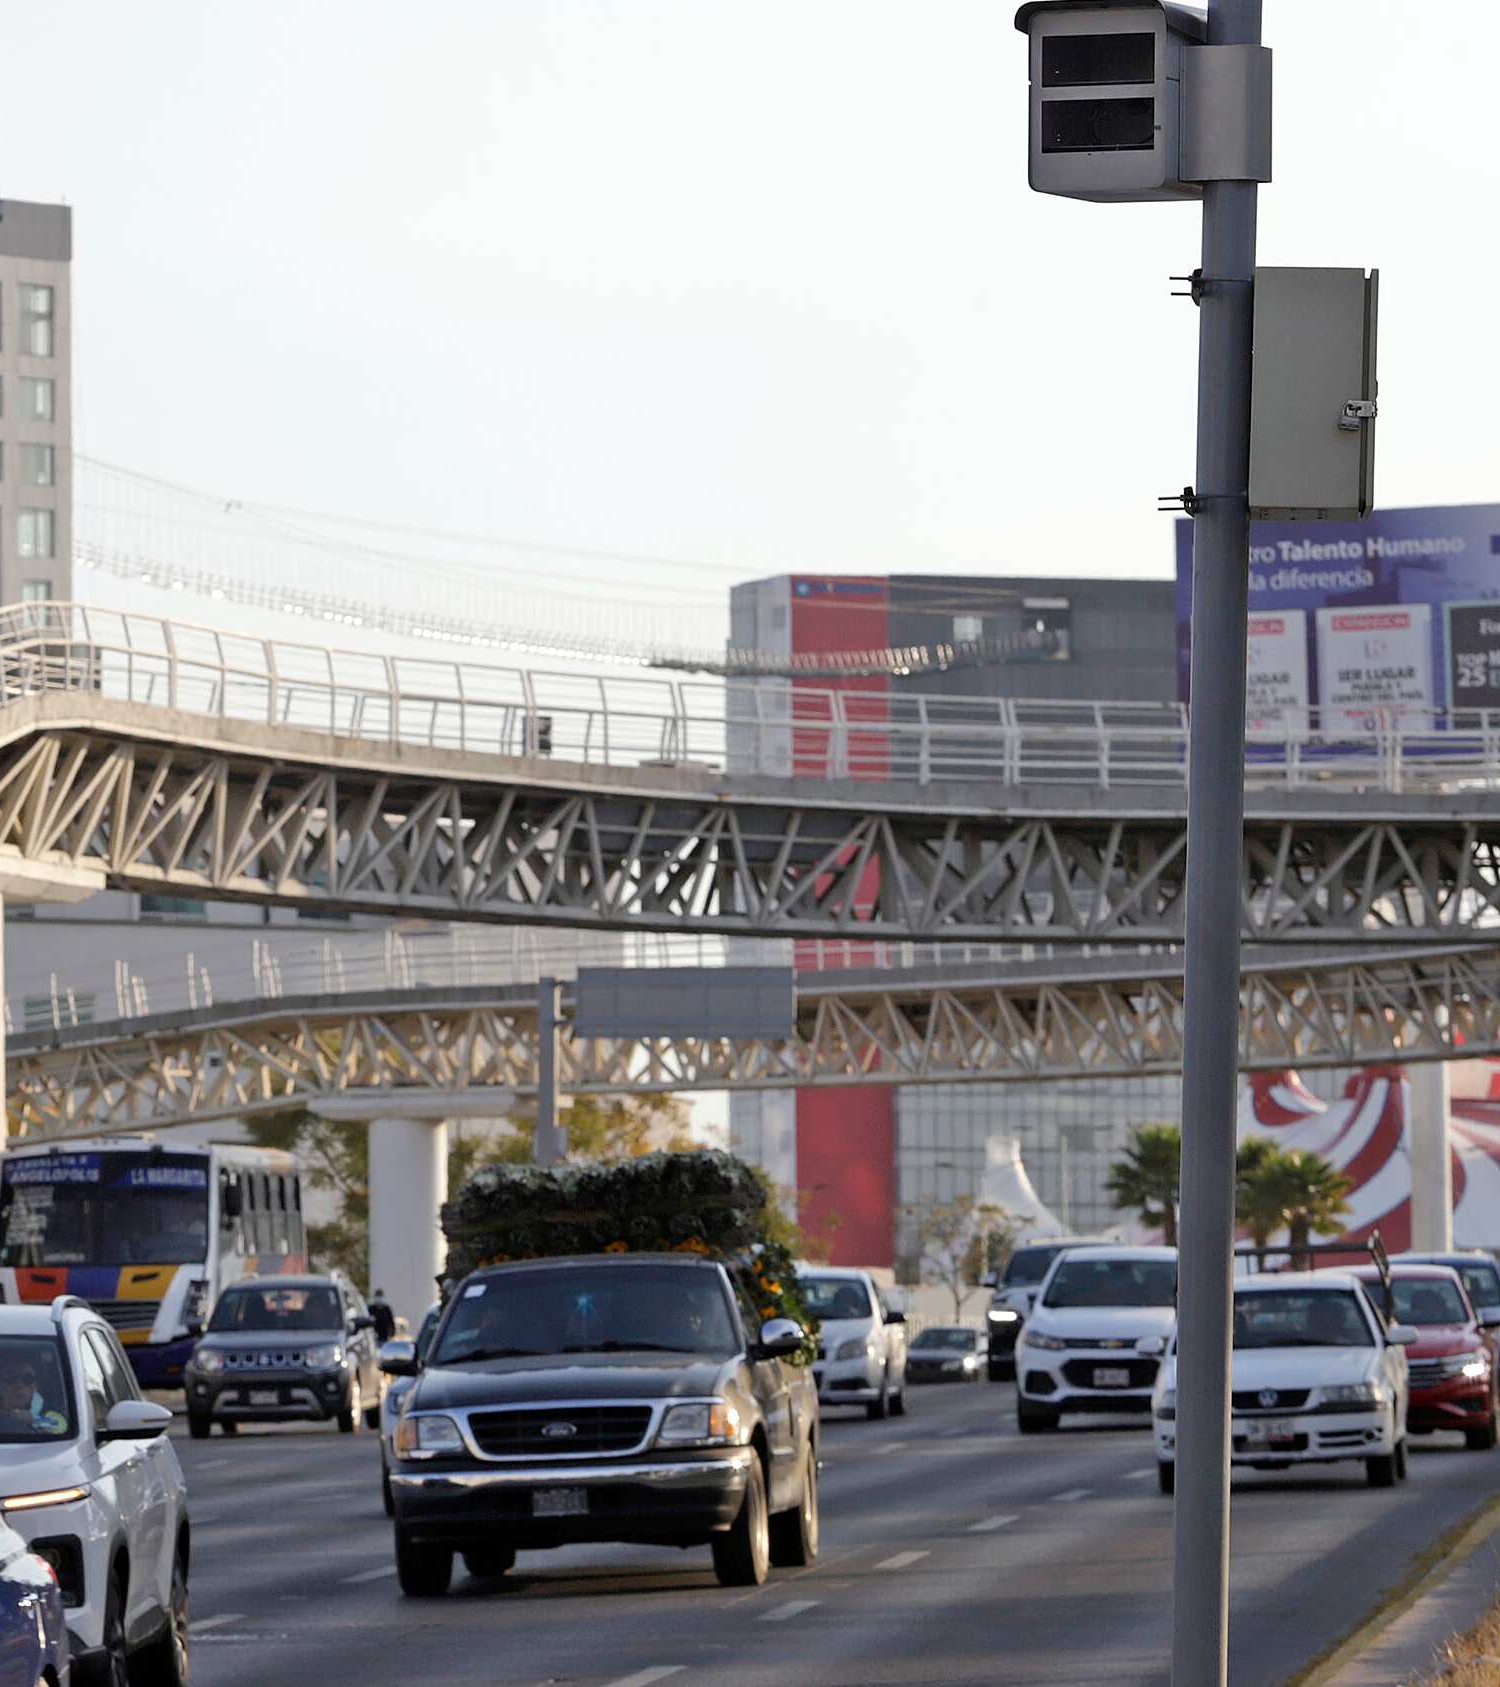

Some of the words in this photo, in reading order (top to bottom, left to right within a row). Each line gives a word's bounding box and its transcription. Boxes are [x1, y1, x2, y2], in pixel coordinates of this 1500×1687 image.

[1277, 539, 1364, 562] Talento
[1366, 536, 1466, 559] Humano
[1269, 565, 1374, 590] diferencia
[1456, 653, 1487, 668] TOP
[1366, 666, 1415, 680] LUGAR
[1458, 667, 1486, 688] 25
